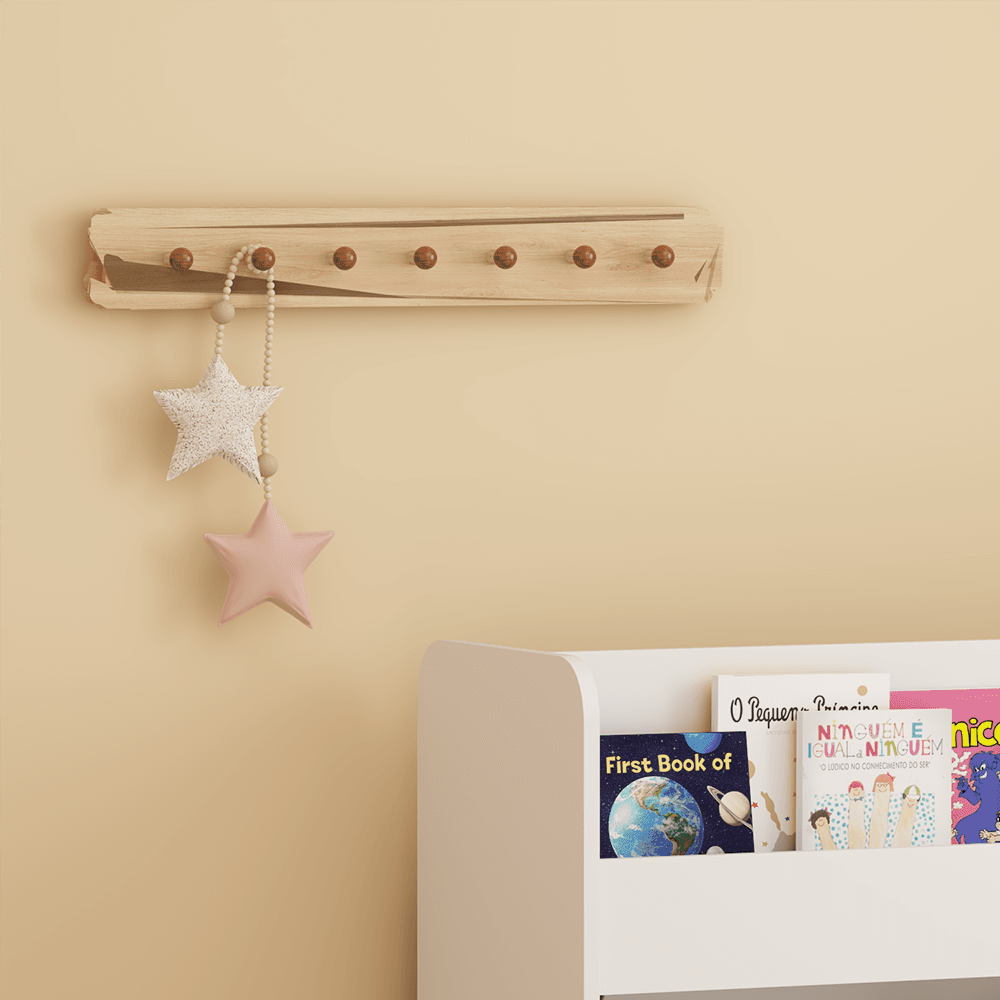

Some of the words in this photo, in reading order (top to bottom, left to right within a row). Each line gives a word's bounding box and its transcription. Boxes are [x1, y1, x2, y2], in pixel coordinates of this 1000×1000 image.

[730, 697, 743, 723] O
[748, 696, 809, 729] Pequen
[911, 718, 924, 739] É
[808, 741, 856, 759] IGUAL
[856, 749, 864, 759] a
[605, 755, 653, 774] First
[657, 753, 707, 772] Book
[712, 752, 732, 771] of
[827, 762, 850, 771] LÚDICO
[850, 762, 861, 770] NO
[861, 761, 908, 770] CONHECIMENTO
[908, 761, 919, 769] DO
